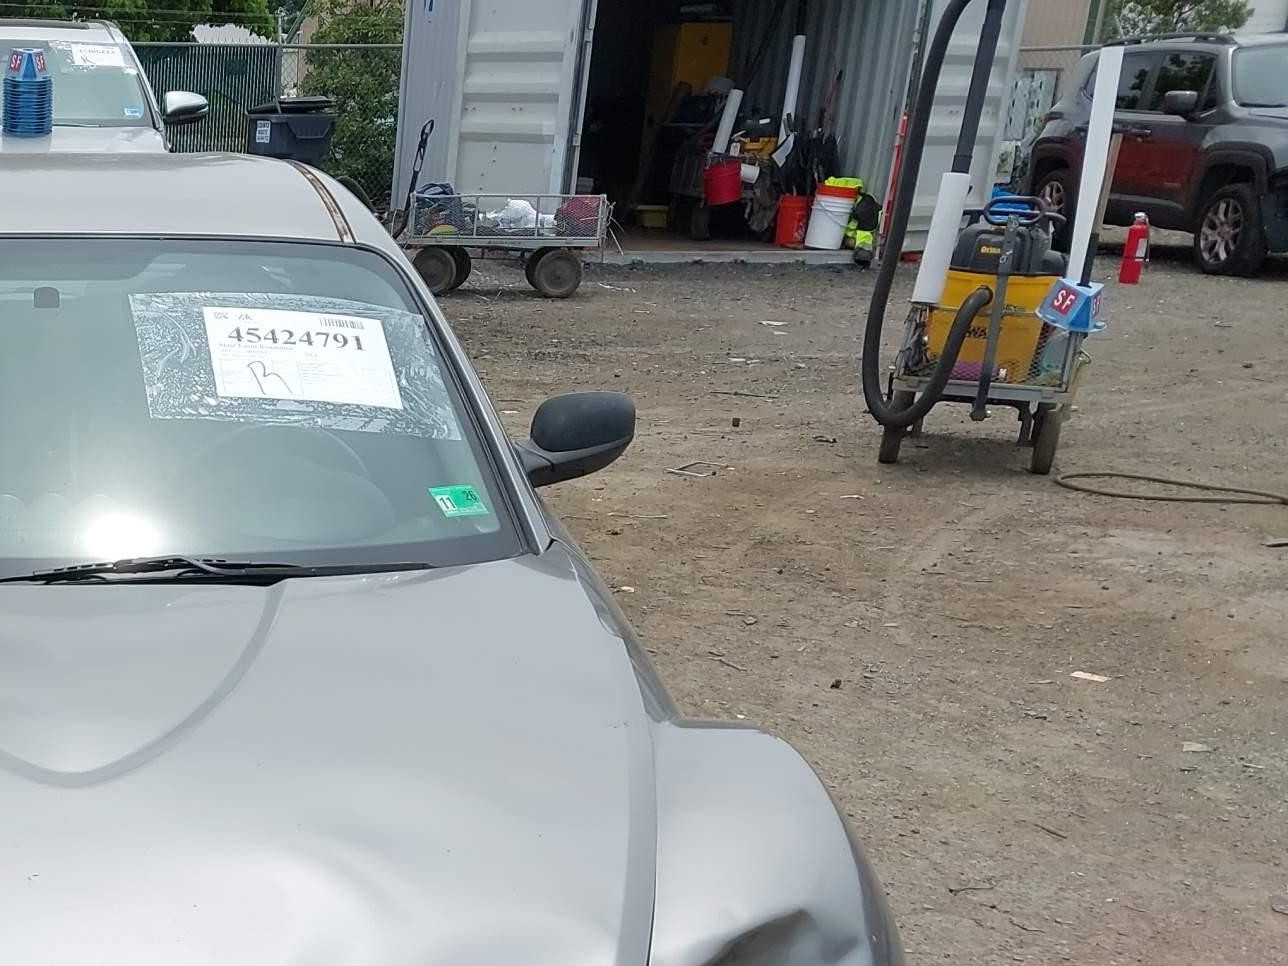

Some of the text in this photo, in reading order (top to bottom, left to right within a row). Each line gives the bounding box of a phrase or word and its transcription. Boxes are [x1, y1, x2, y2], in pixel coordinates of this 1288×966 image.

[11, 55, 22, 69] SF
[35, 54, 45, 70] SF
[1053, 289, 1076, 310] SF
[227, 326, 367, 352] 45424791
[439, 496, 456, 510] 11
